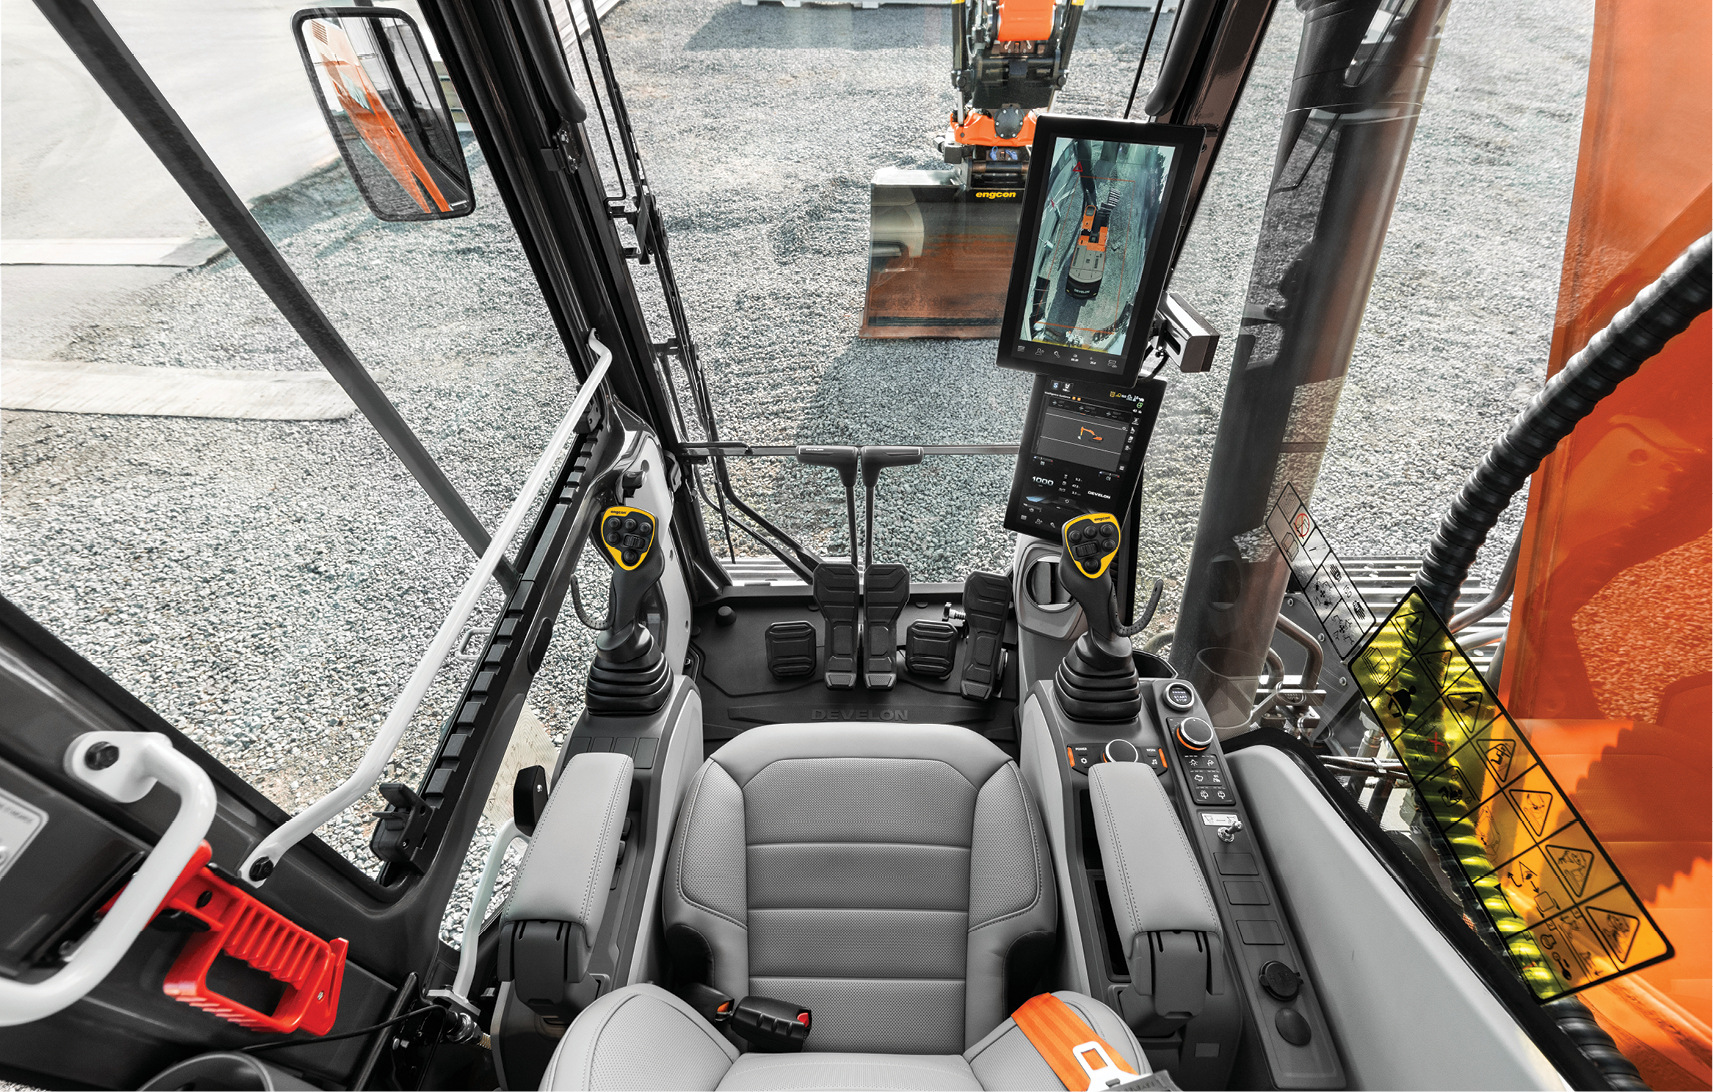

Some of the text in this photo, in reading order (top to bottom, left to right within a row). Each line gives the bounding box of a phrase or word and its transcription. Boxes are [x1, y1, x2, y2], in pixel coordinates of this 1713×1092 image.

[975, 191, 1017, 199] engcon
[1032, 475, 1054, 486] 1000
[1087, 490, 1111, 500] DEVELON
[811, 709, 908, 721] DEVELON
